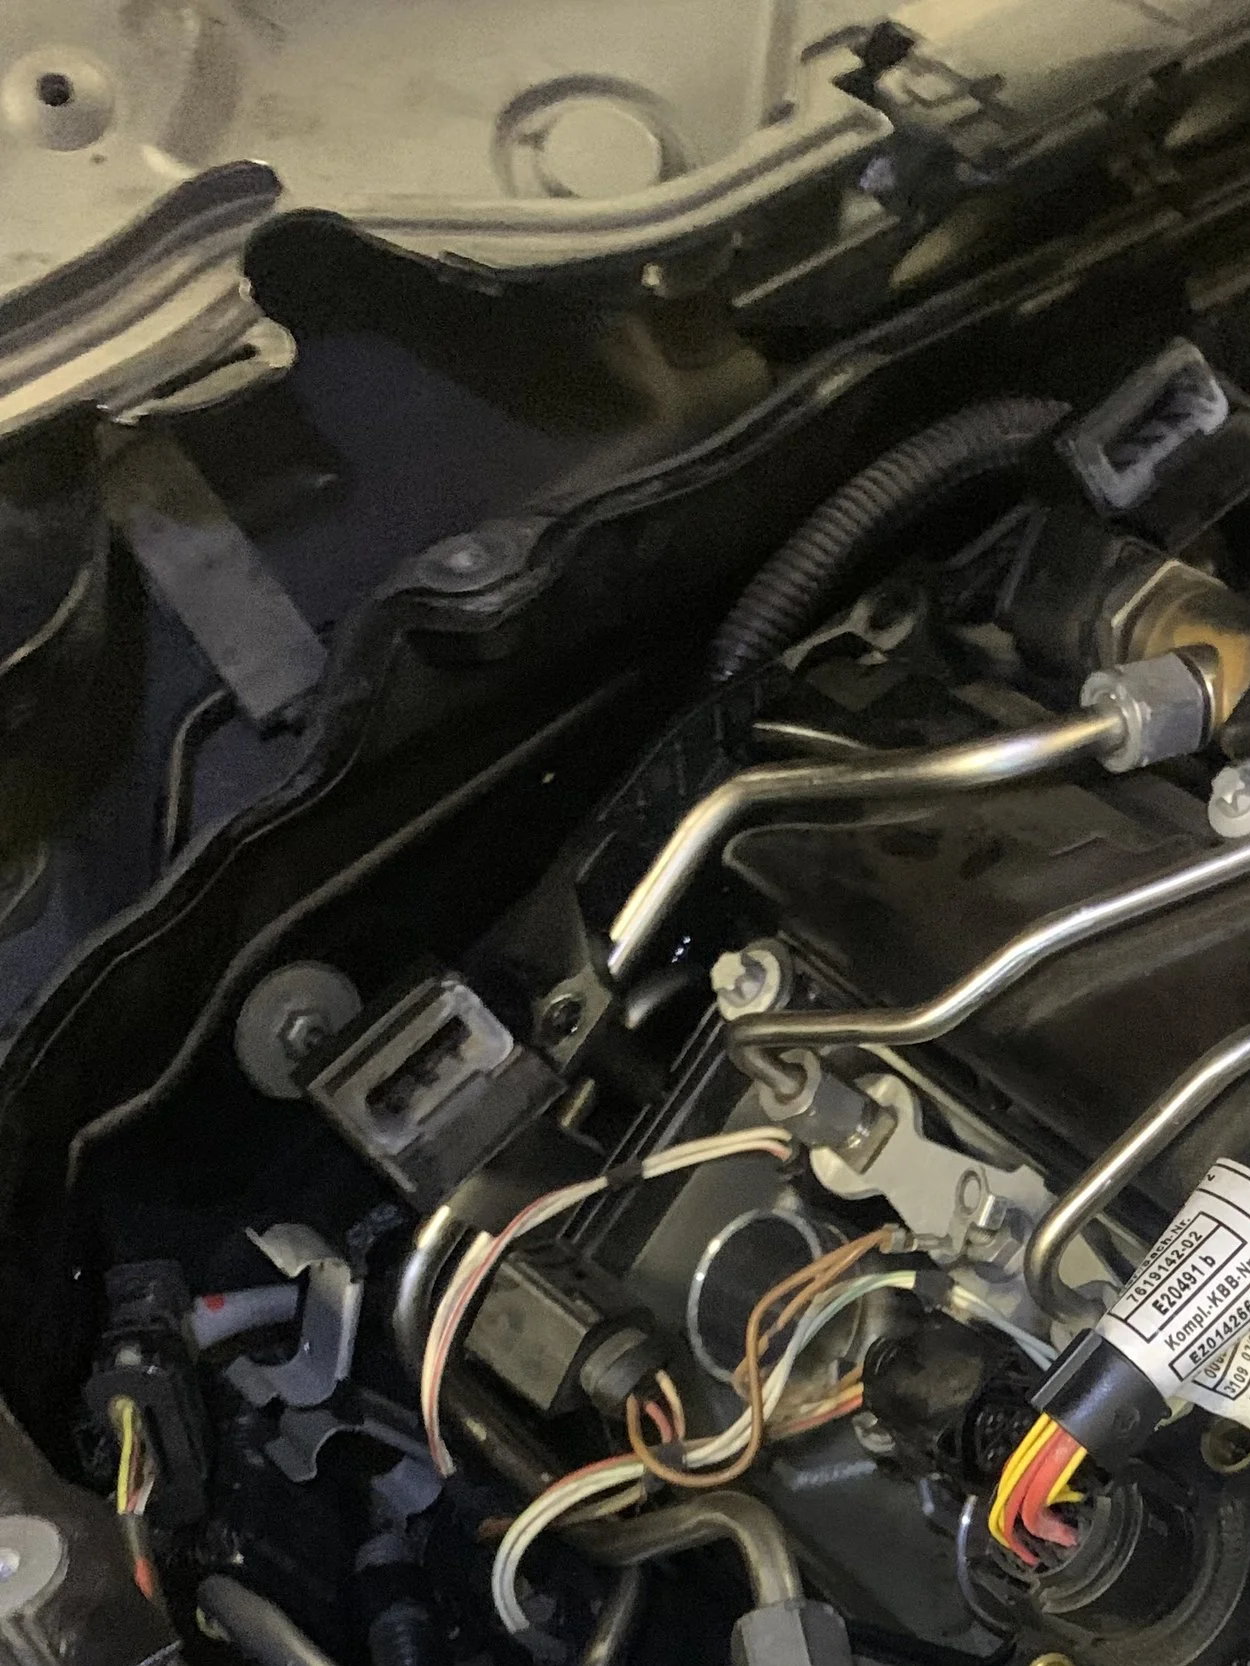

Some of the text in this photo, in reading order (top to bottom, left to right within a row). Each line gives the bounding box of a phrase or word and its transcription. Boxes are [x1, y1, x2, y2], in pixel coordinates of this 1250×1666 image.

[1126, 1230, 1203, 1303] 7619142-02
[1151, 1254, 1217, 1316] E20491 b
